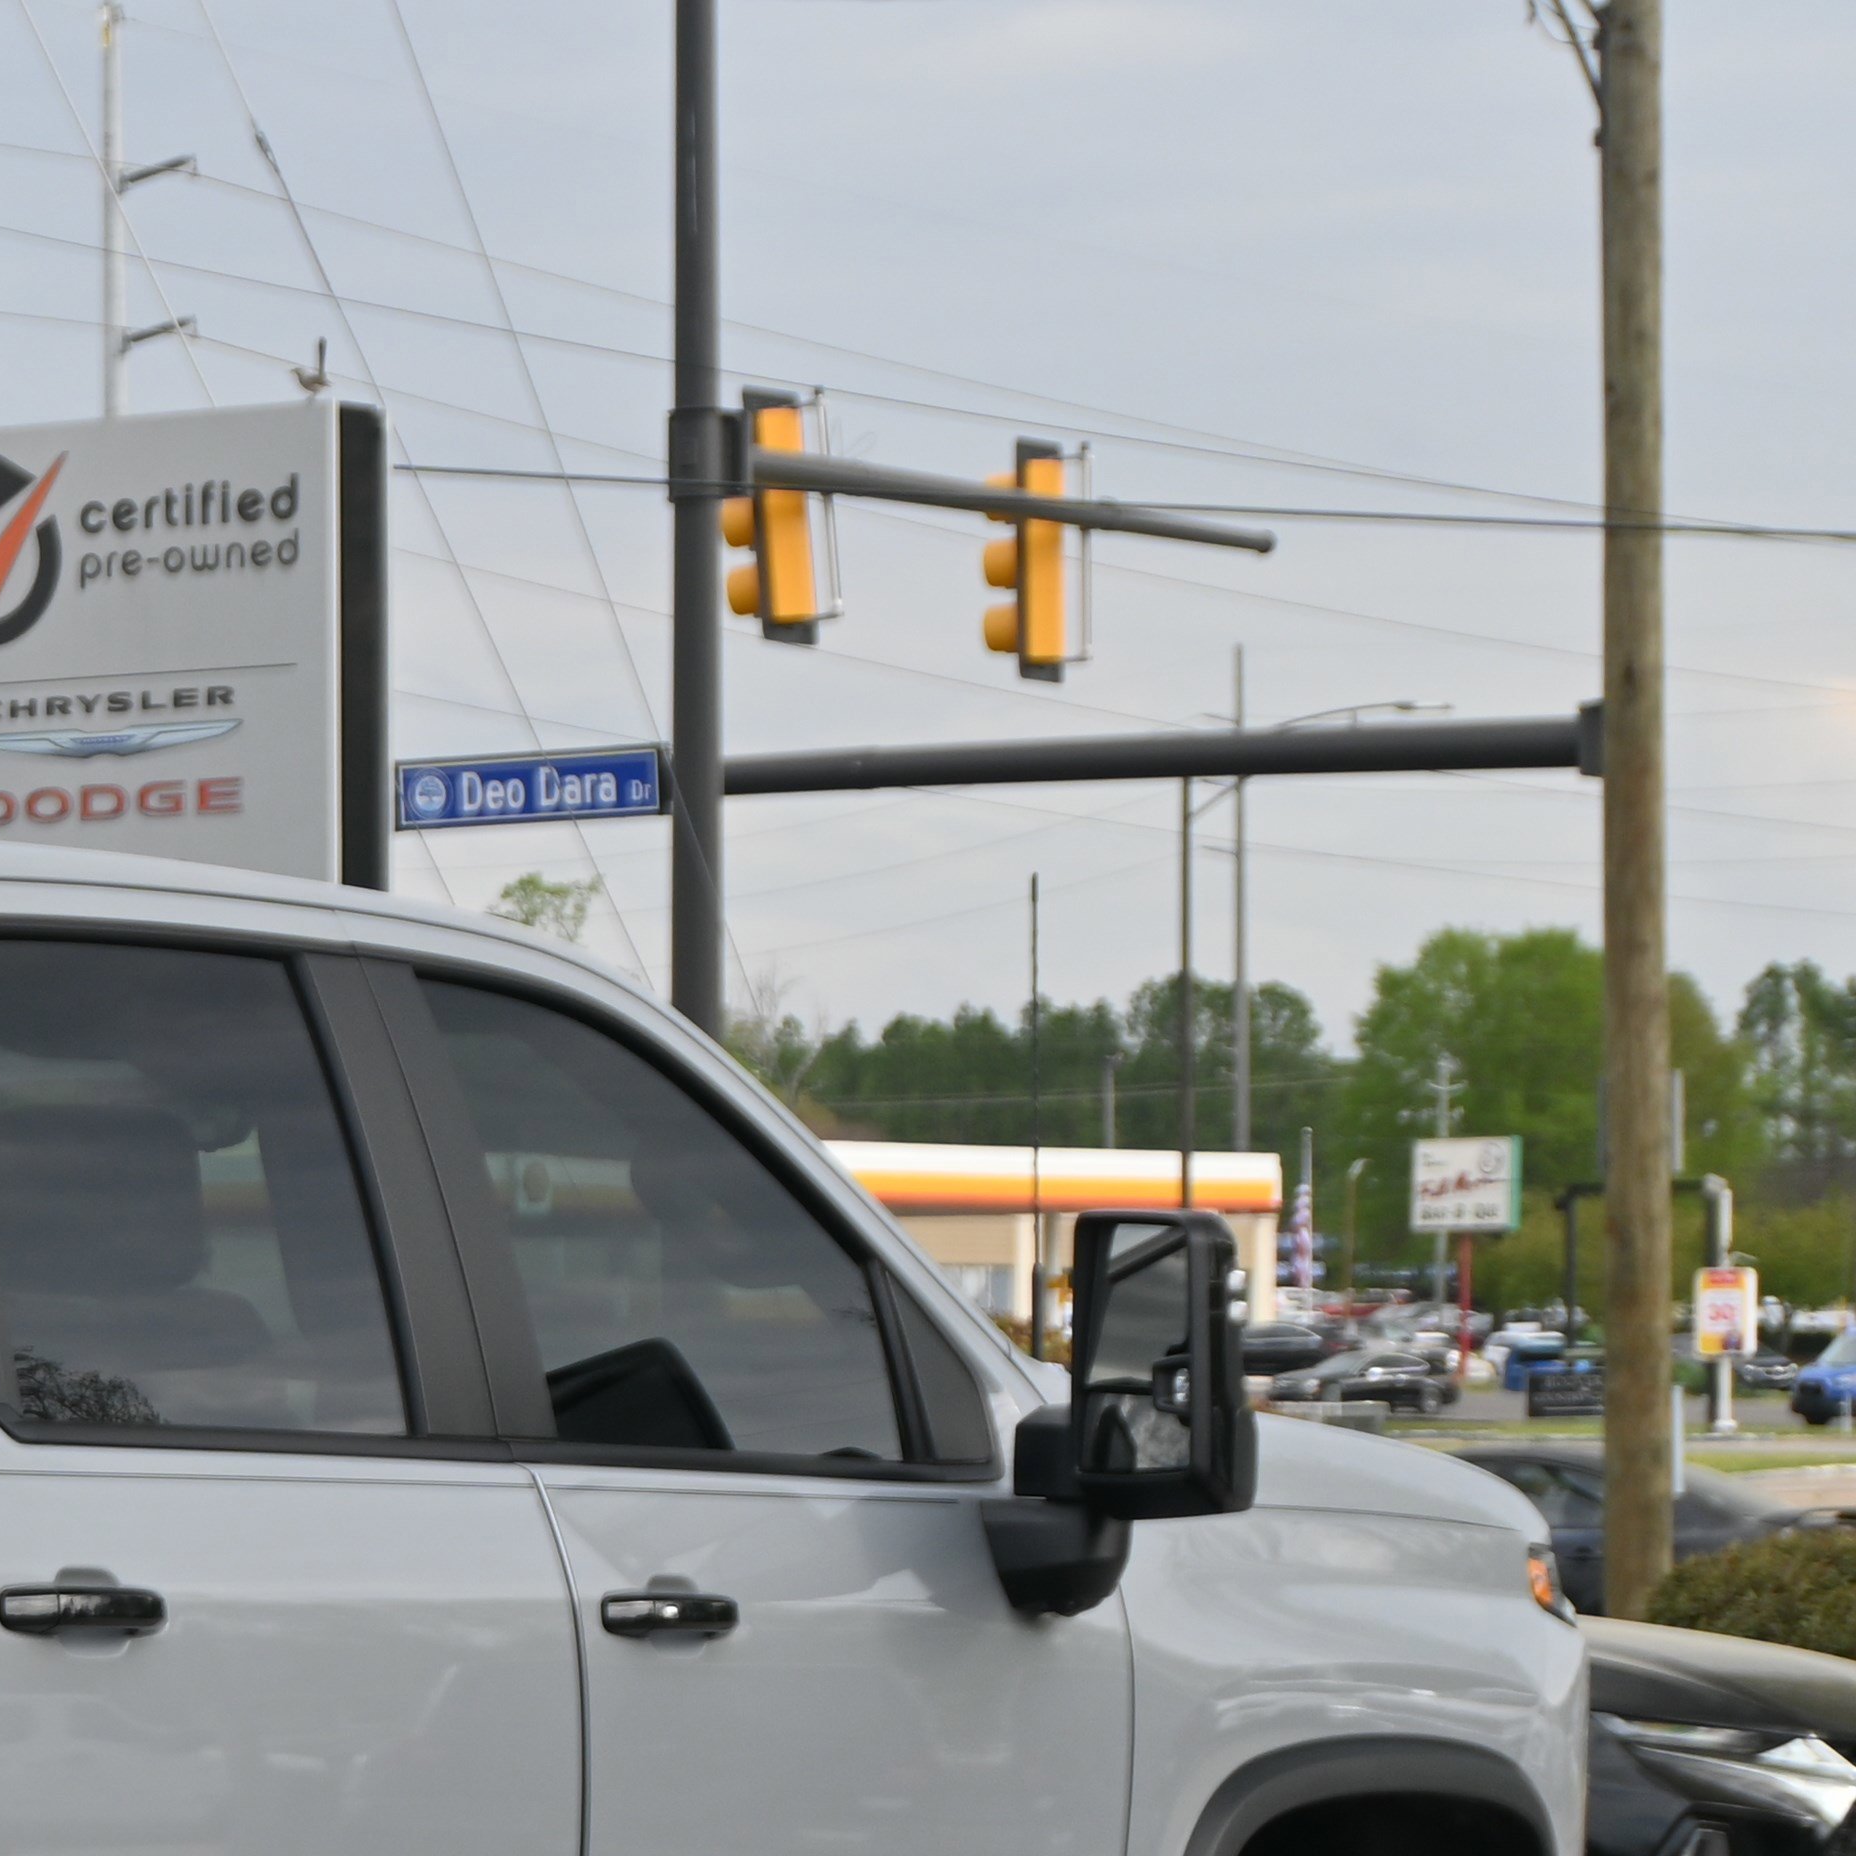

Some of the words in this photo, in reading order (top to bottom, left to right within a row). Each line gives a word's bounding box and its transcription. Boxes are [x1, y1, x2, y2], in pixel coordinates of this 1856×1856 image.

[79, 471, 300, 532] certified
[78, 528, 300, 589] pre-owned
[462, 770, 526, 811] Deo
[538, 765, 617, 807] Dara
[630, 779, 652, 801] Dr
